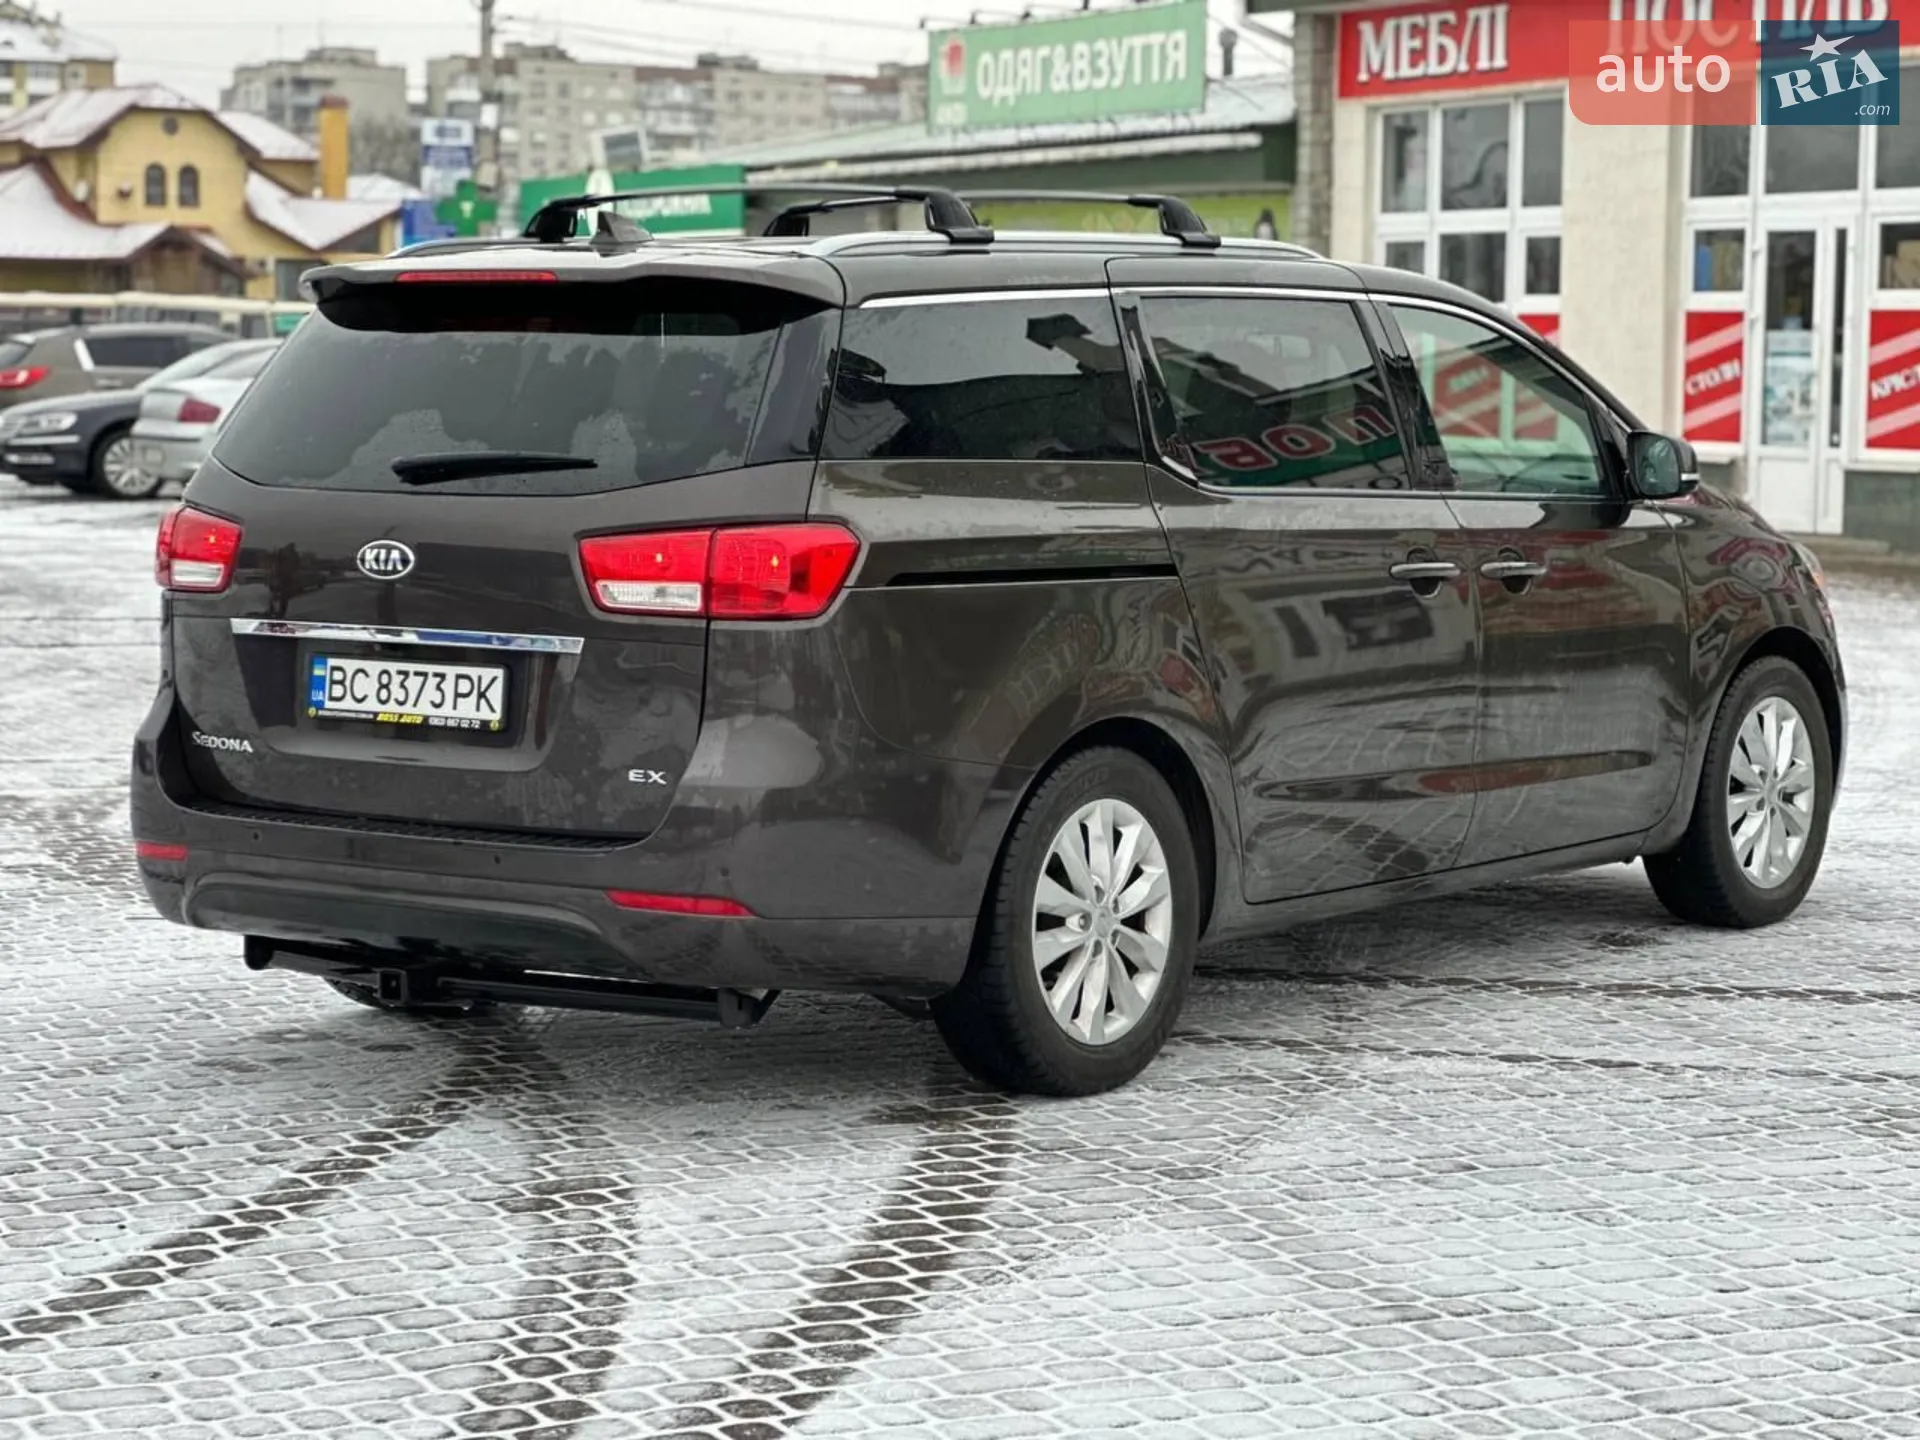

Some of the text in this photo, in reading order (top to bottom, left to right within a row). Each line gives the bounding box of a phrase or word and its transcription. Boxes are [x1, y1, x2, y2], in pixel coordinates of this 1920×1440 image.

[1357, 5, 1509, 83] МЕБЛІ
[976, 29, 1187, 107] ОДЯГ&ВЗУТТЯ
[365, 548, 403, 571] KIA
[327, 665, 499, 714] BC 8373 PK
[192, 731, 254, 754] SEDONA
[628, 769, 668, 785] EX
